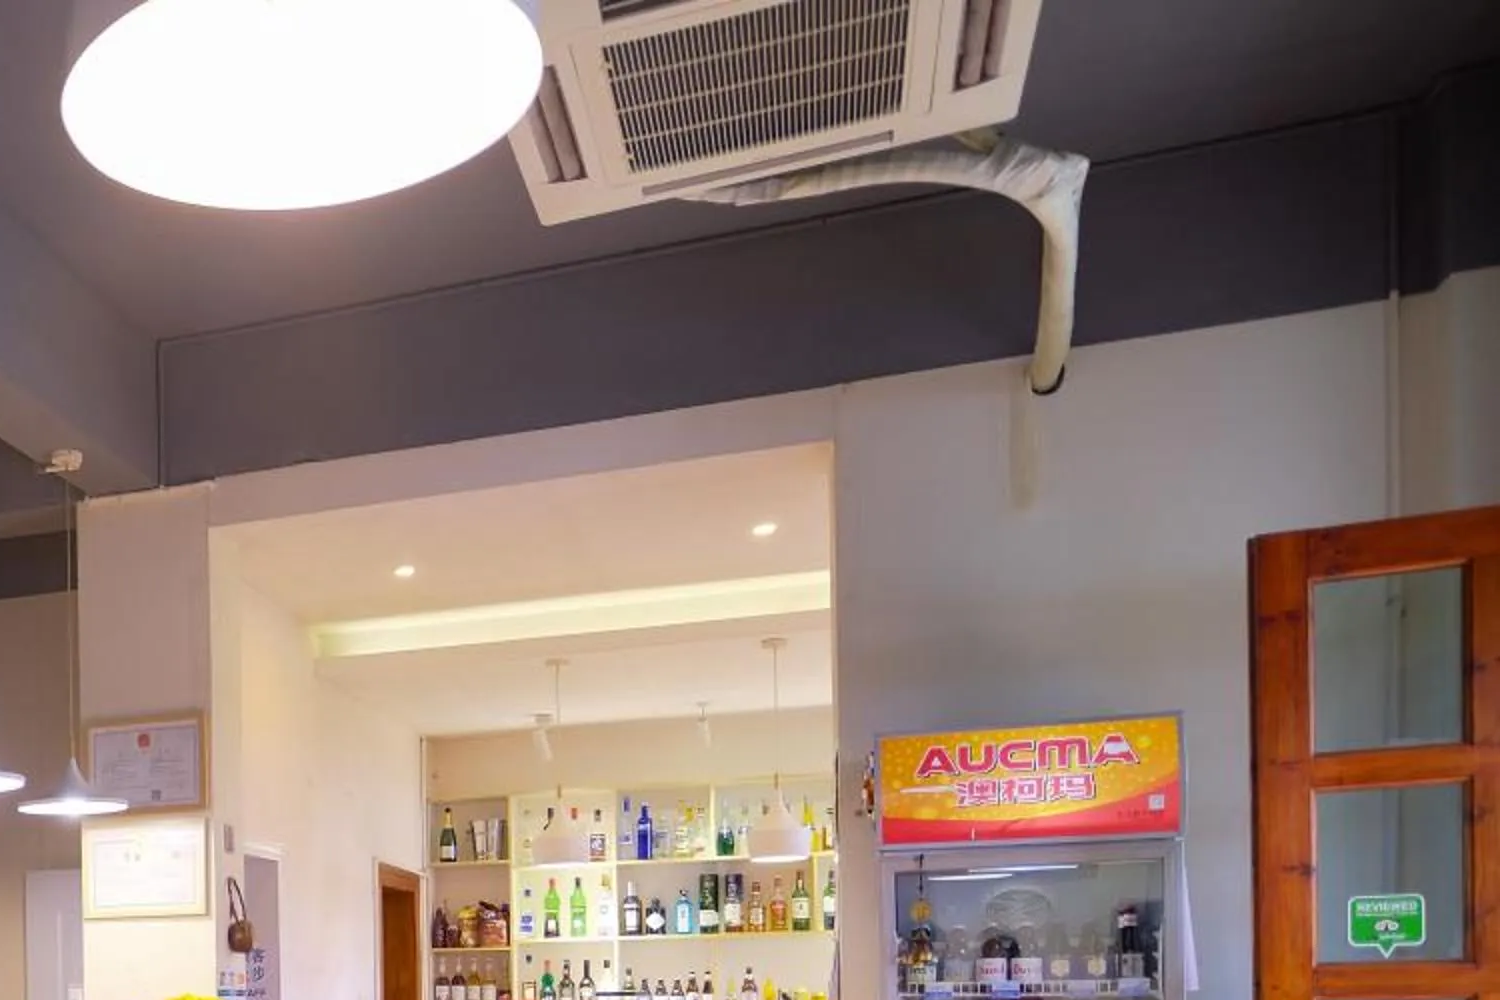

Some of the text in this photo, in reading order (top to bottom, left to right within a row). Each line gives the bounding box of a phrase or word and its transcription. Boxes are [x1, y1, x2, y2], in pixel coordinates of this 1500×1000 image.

[916, 733, 1140, 778] AUCMA
[955, 773, 1097, 807] 澳柯玛
